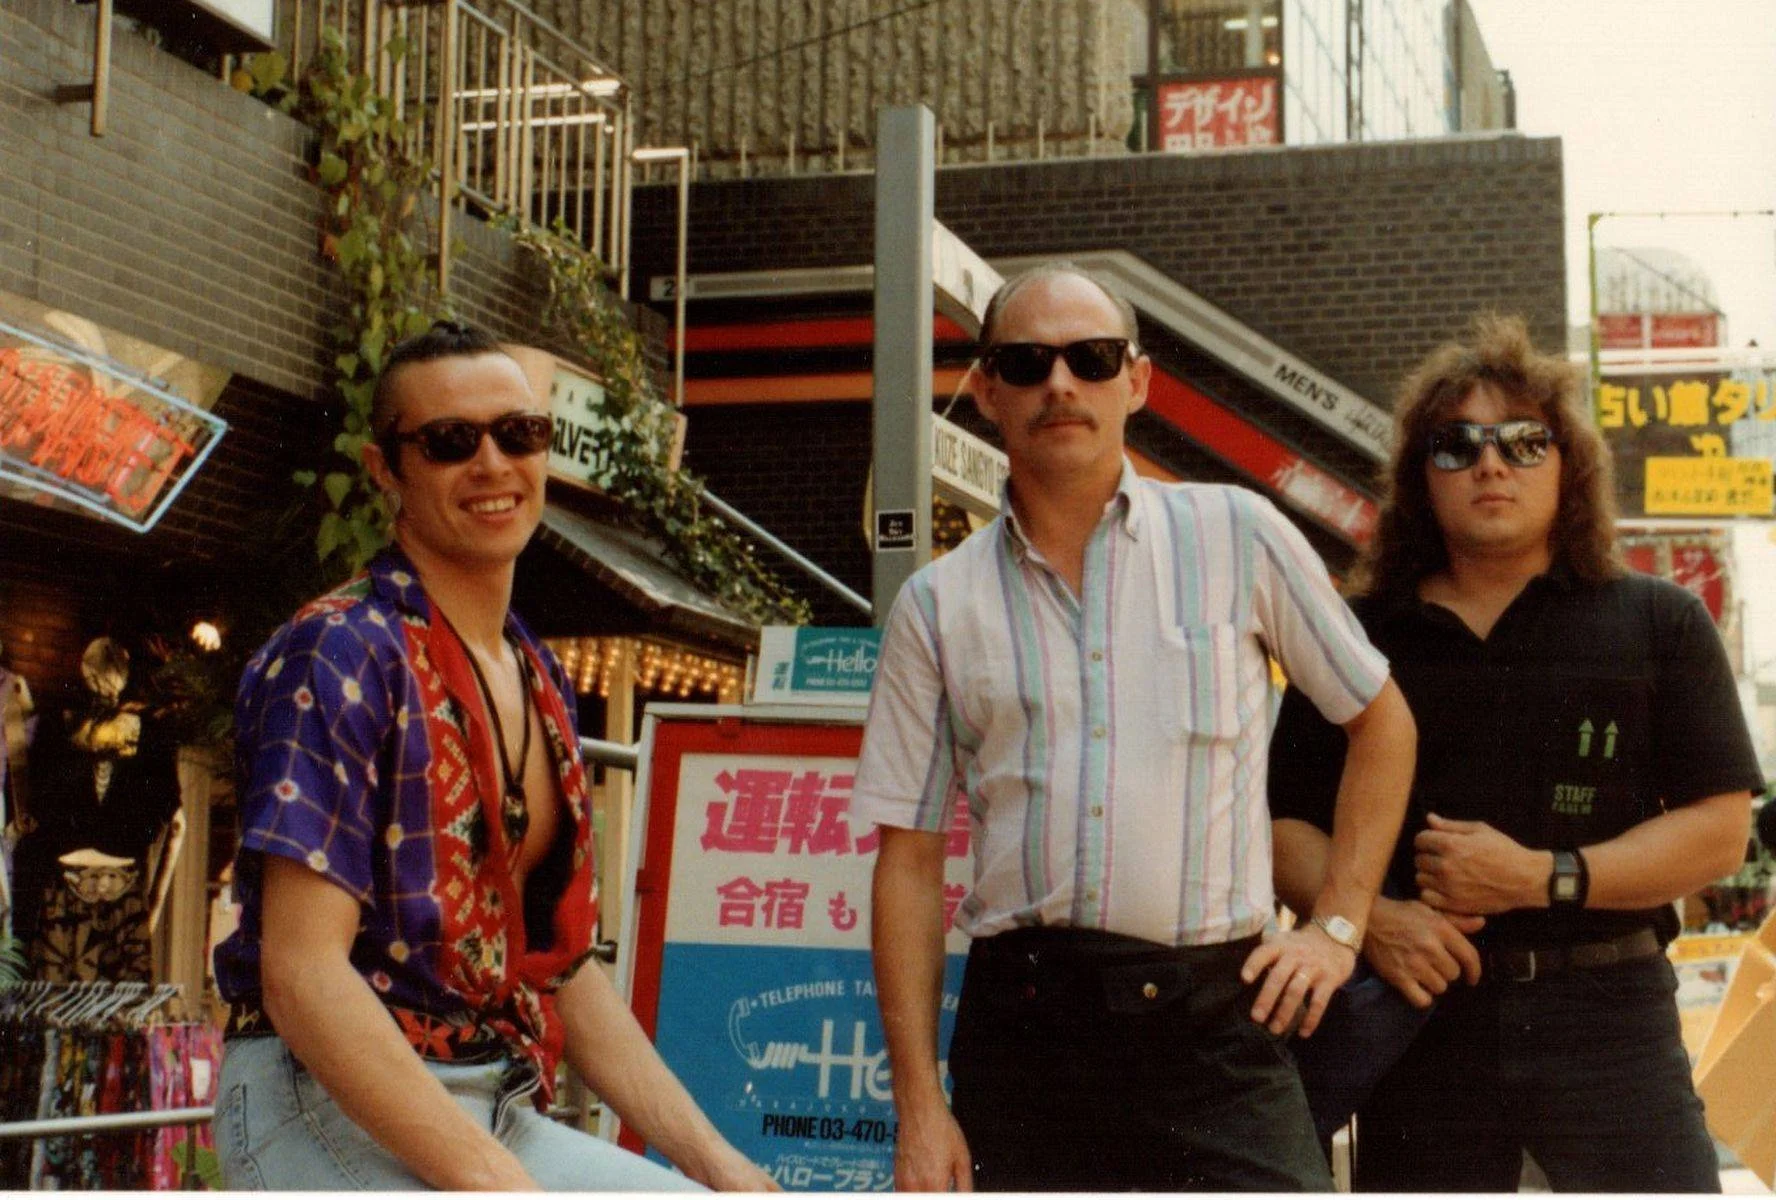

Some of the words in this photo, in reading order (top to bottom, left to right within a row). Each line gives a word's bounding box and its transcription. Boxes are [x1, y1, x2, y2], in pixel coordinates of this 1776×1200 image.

[1164, 85, 1273, 128] デザイン
[825, 644, 878, 674] Hello
[700, 769, 880, 856] 運転
[716, 875, 811, 930] 合宿
[758, 979, 845, 1010] TELEPHONE
[854, 980, 878, 997] TA
[816, 1018, 893, 1101] He
[761, 1113, 818, 1141] PHONE
